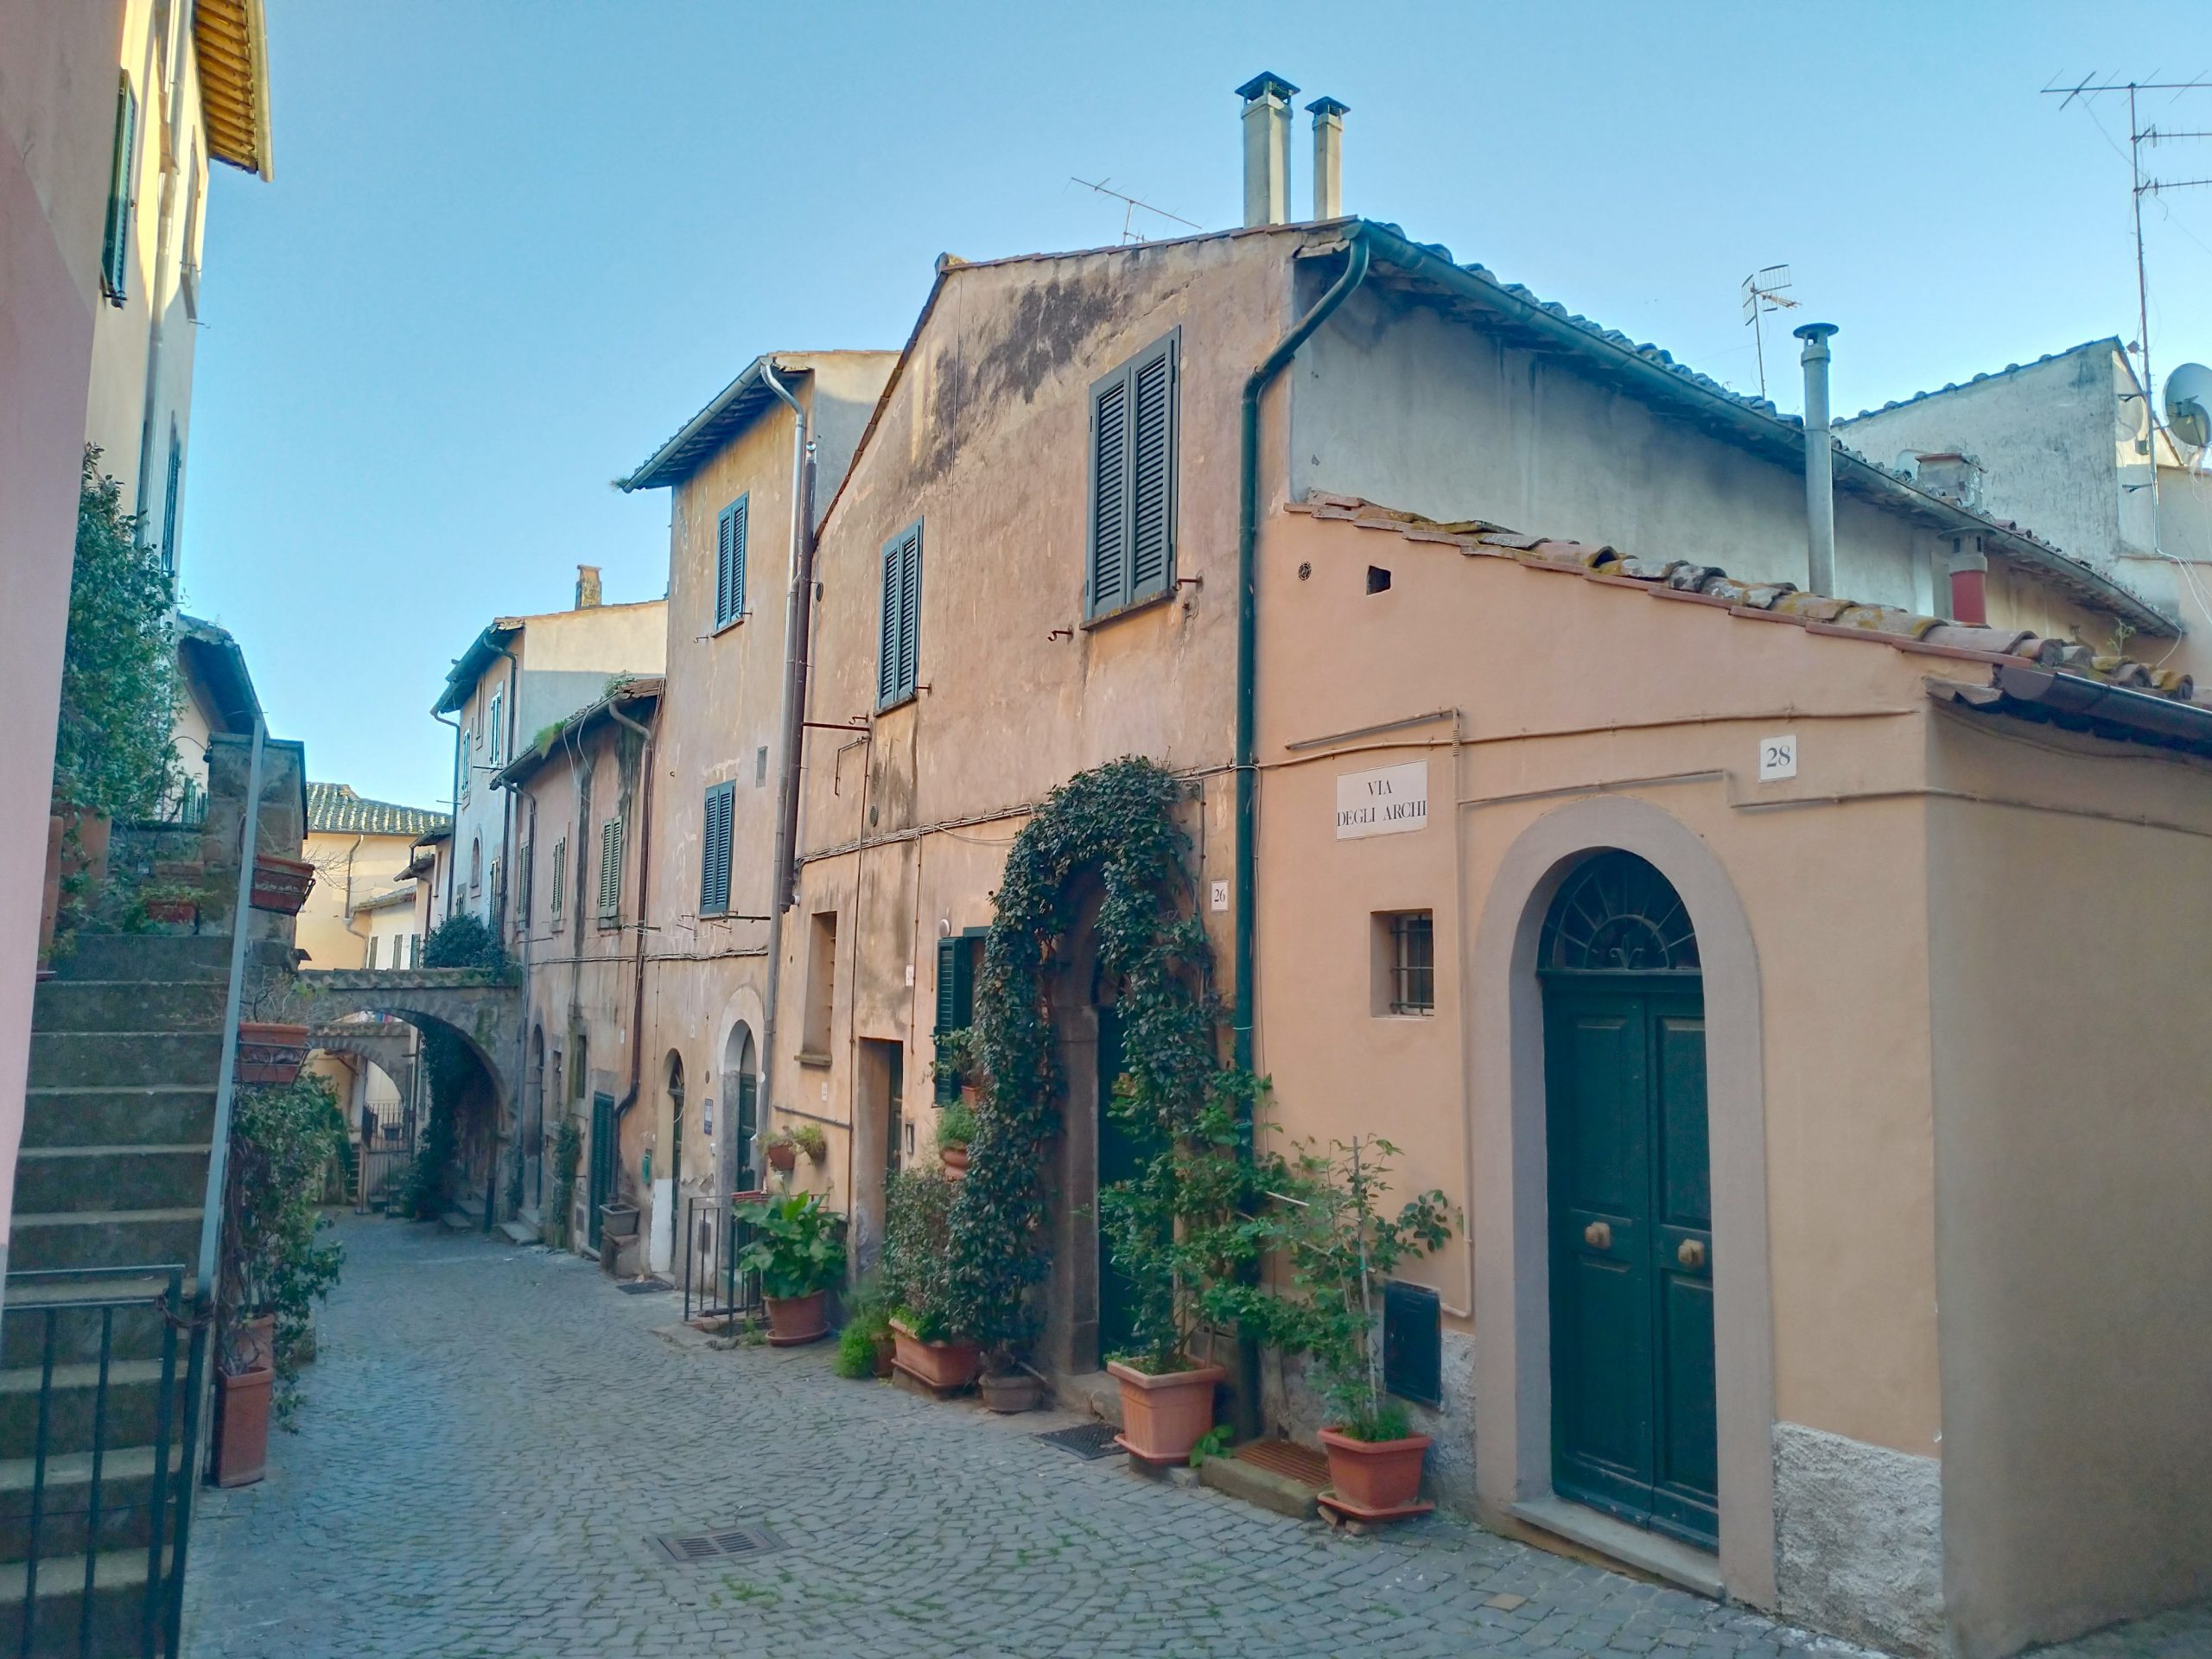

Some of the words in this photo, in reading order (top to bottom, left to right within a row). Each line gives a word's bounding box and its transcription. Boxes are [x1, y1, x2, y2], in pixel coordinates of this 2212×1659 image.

[1766, 745, 1790, 767] 28
[1367, 779, 1393, 796] VIA
[1337, 807, 1376, 827] DEGLI
[1382, 800, 1427, 821] ARCHI
[1214, 888, 1225, 903] 26
